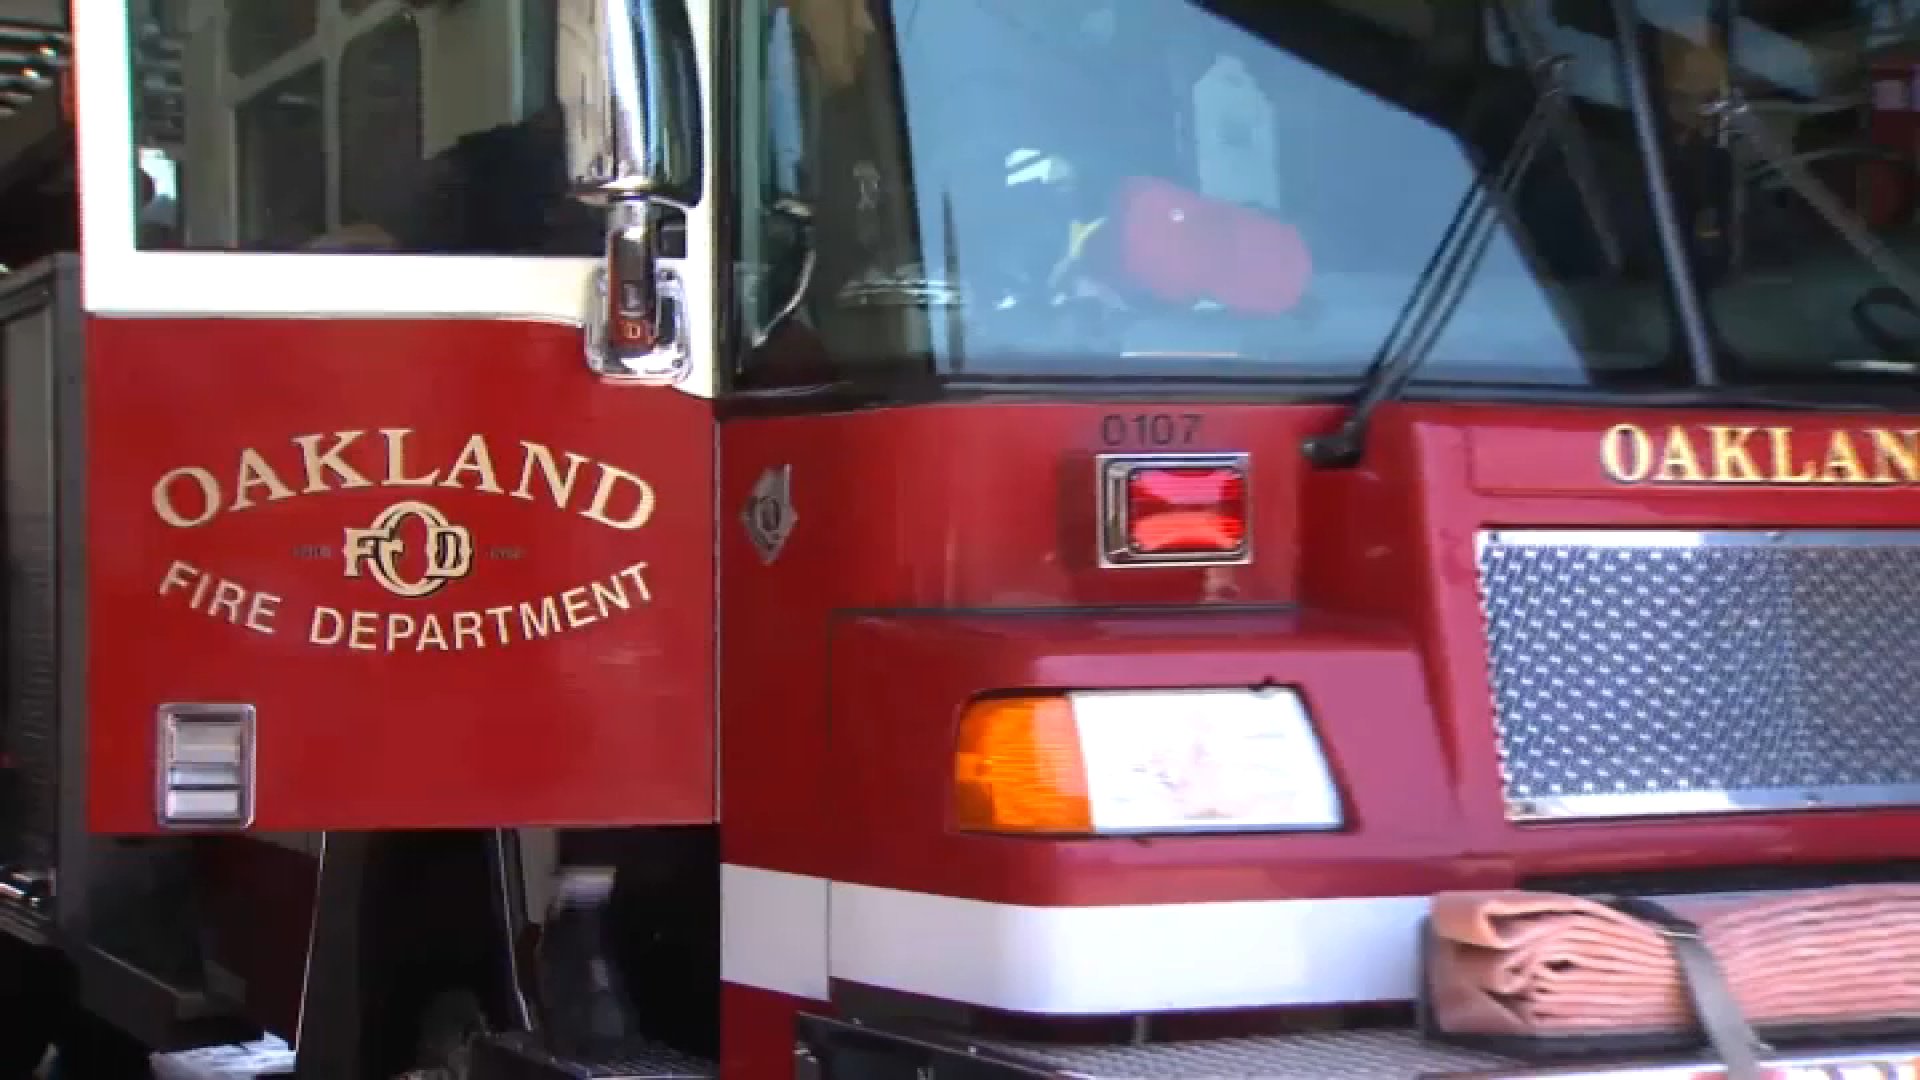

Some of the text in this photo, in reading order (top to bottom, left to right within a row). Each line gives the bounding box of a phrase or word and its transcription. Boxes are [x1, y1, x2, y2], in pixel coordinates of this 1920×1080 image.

[1102, 413, 1204, 447] 0107
[151, 427, 657, 531] OAKLAND
[158, 560, 654, 652] FIRE DEPARTMENT
